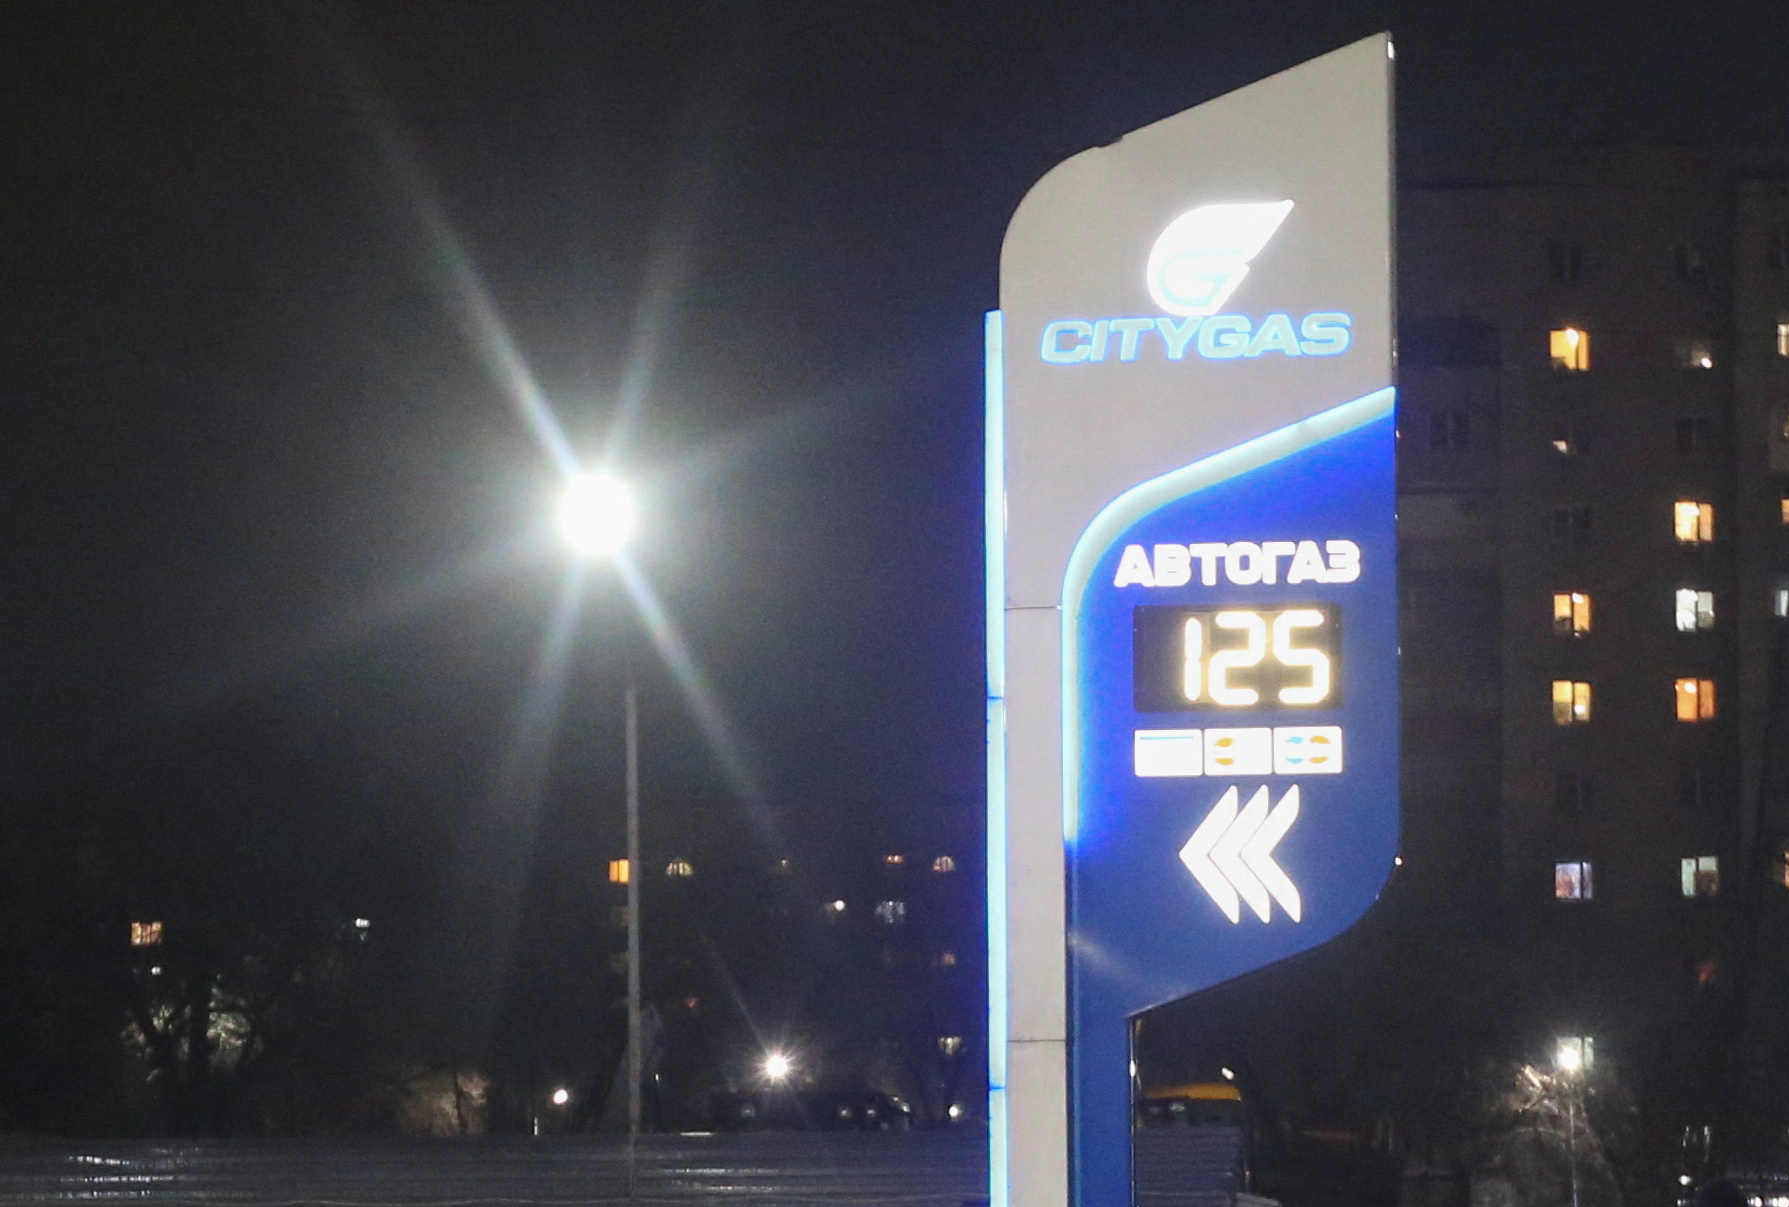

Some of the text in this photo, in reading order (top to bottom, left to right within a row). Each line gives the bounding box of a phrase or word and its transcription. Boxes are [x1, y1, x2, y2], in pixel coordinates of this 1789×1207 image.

[1040, 312, 1353, 364] CITYGAS
[1113, 540, 1361, 588] АВТОГАЗ
[1184, 609, 1331, 706] 125
